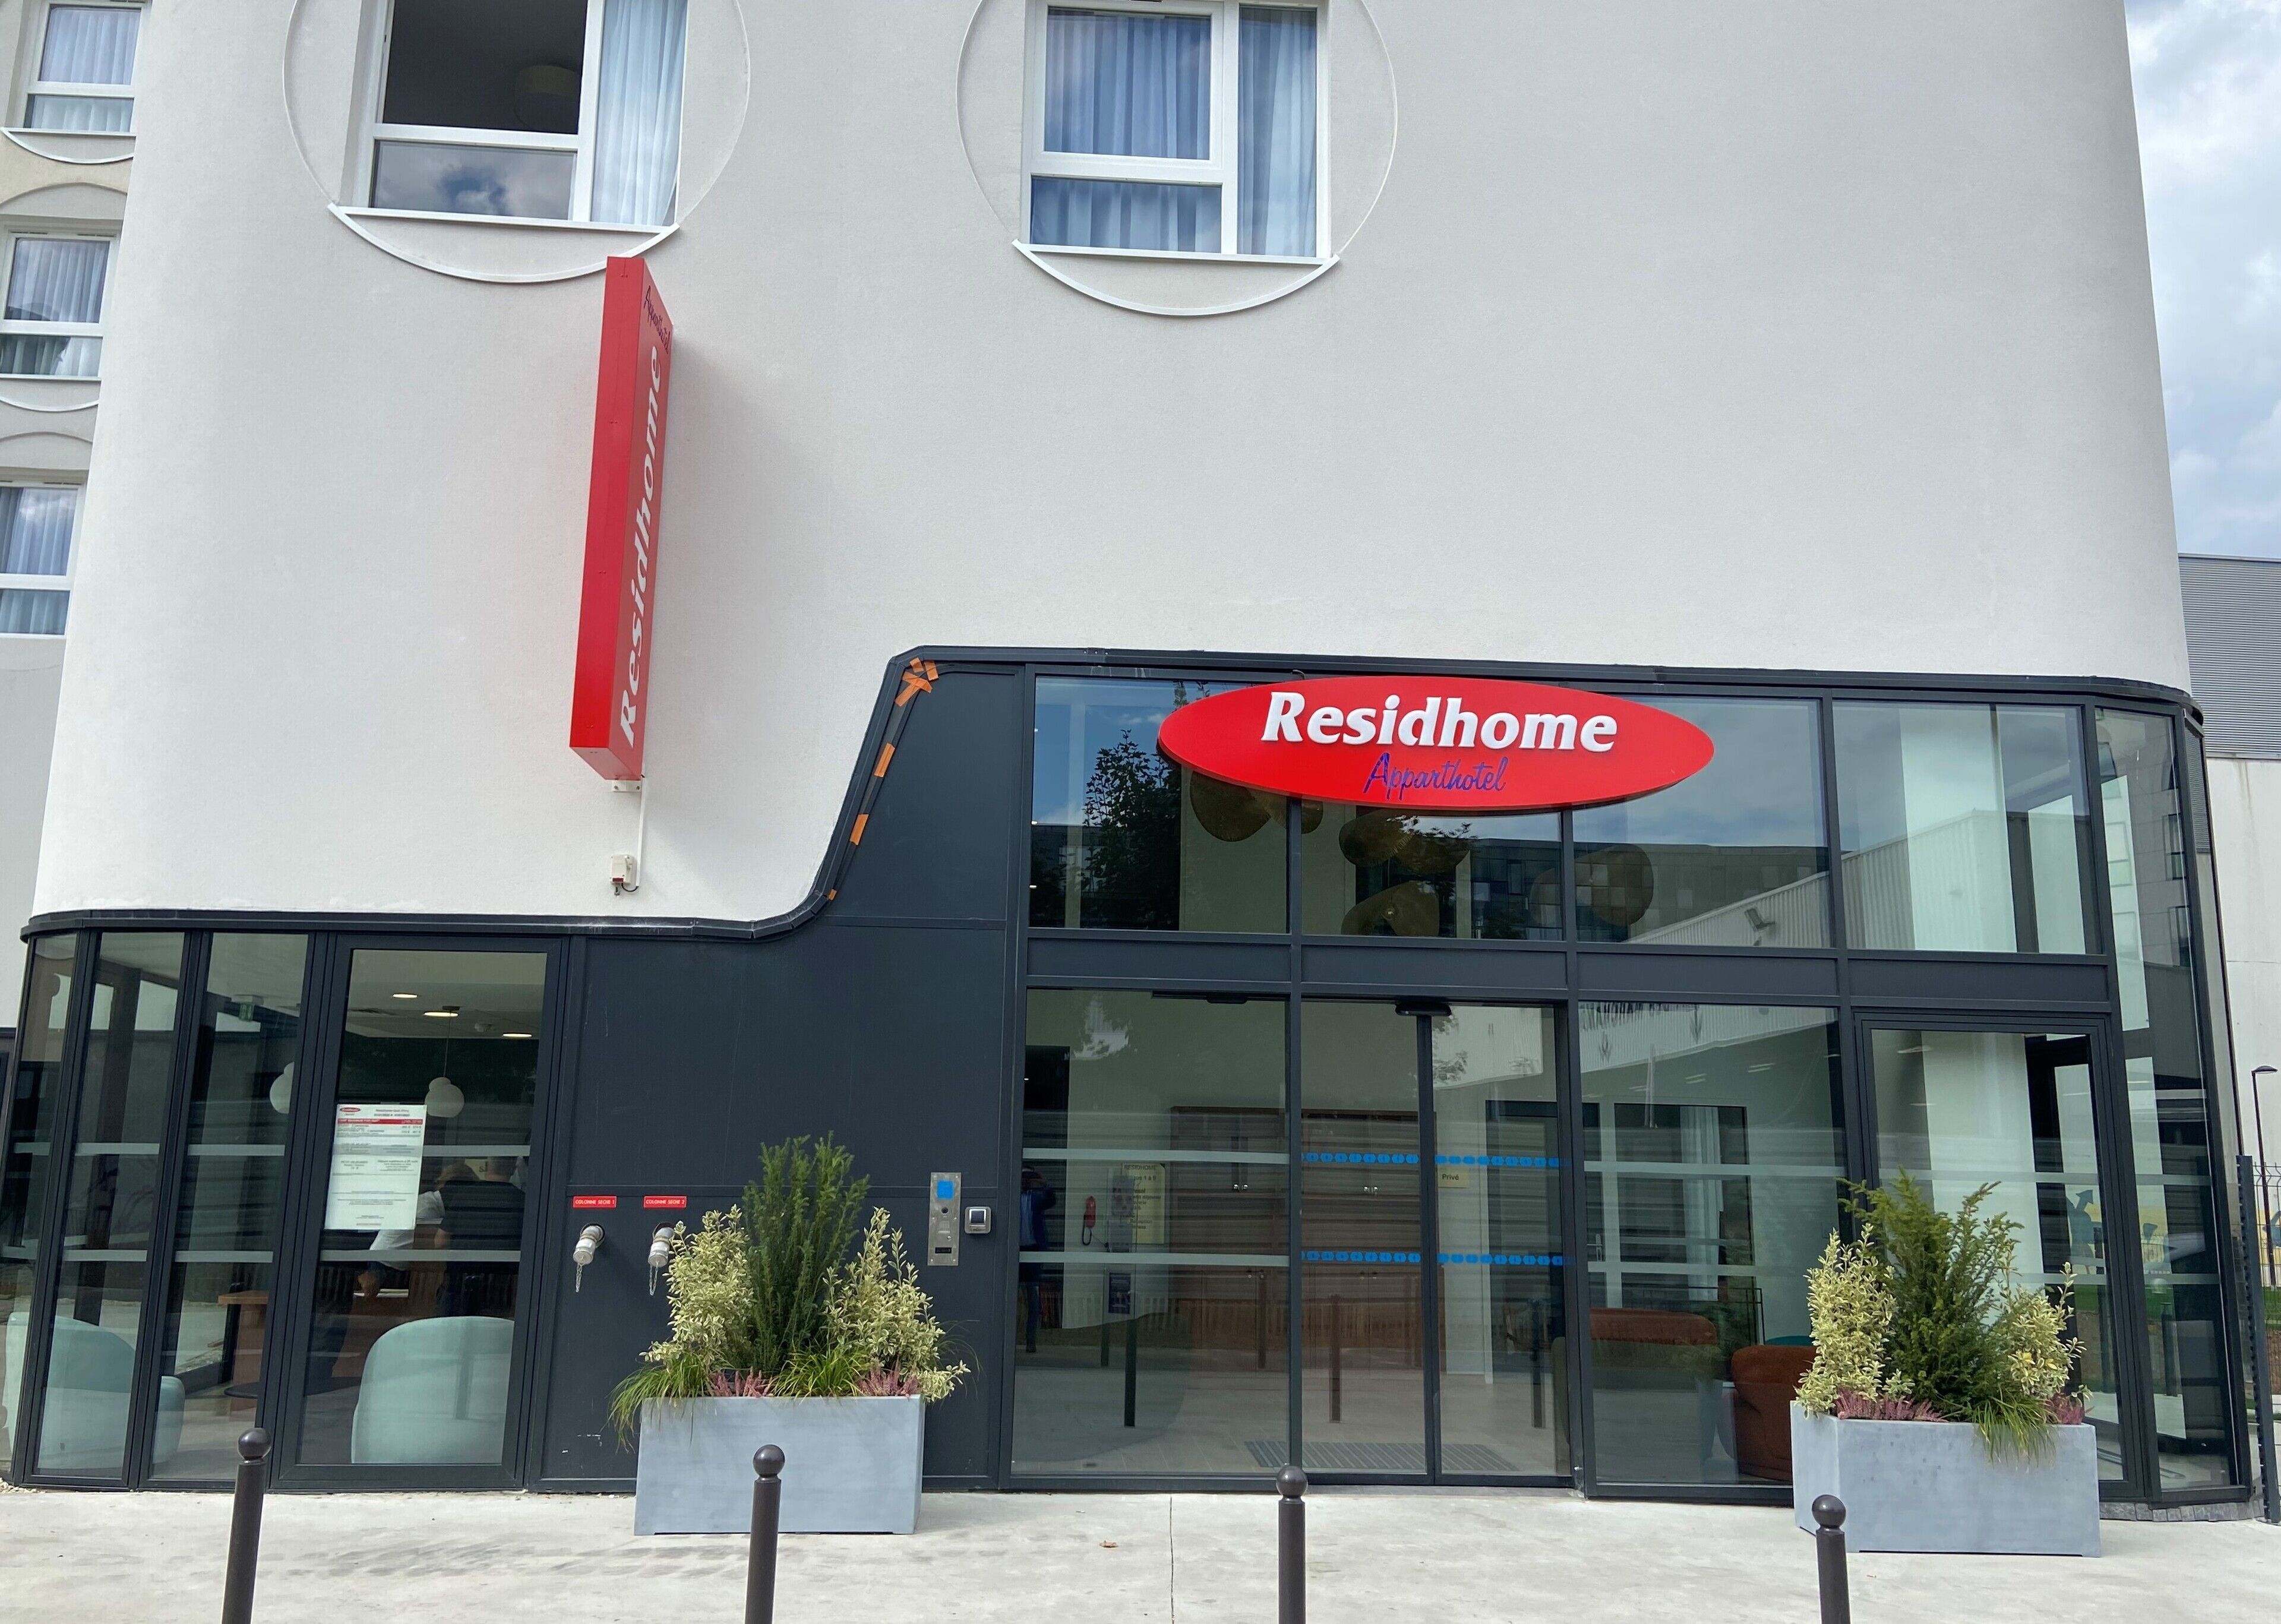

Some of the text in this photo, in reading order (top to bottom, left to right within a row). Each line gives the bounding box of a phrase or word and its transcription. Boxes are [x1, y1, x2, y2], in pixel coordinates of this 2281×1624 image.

[619, 346, 661, 749] Residhome
[1261, 690, 1617, 753] Residhome
[1362, 751, 1509, 800] Apparthotel
